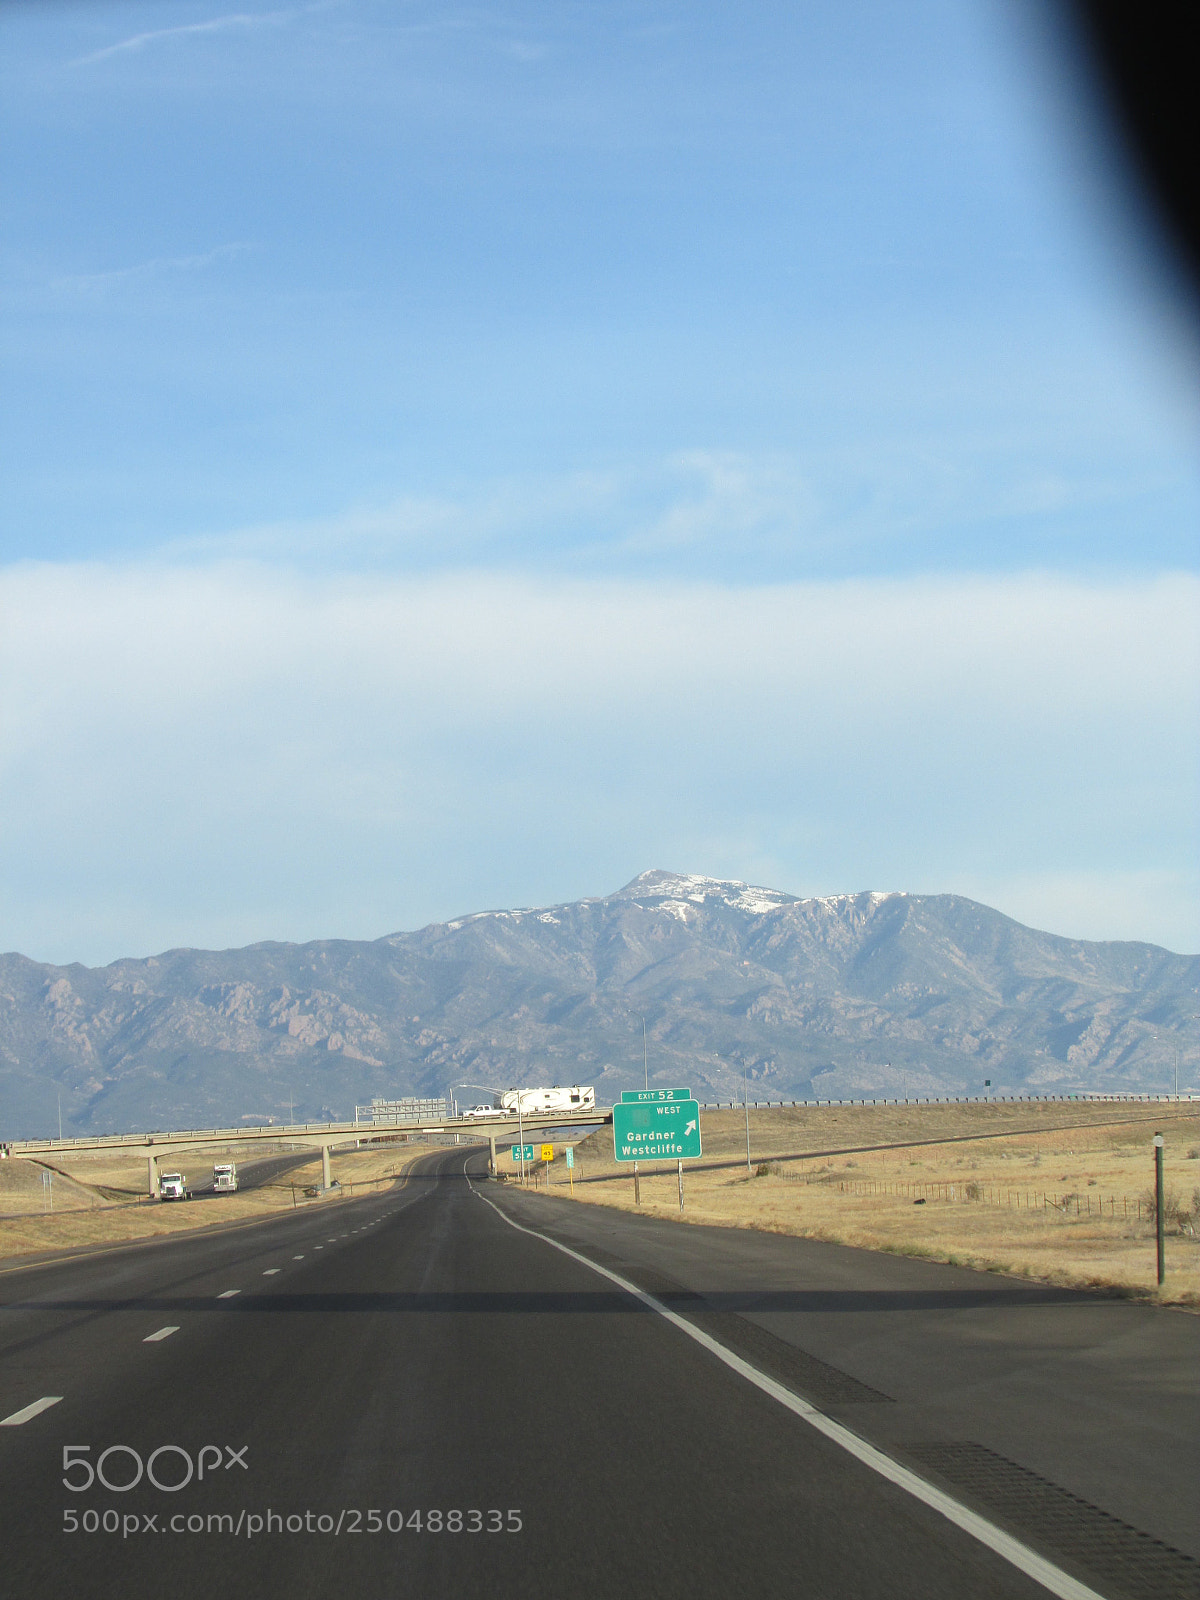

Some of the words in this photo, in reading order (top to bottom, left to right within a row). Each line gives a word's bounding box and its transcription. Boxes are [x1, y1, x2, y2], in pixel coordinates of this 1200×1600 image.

[658, 1091, 674, 1100] 52
[656, 1106, 681, 1115] WEST
[626, 1131, 676, 1142] Gardner
[621, 1144, 683, 1156] Westcliffe
